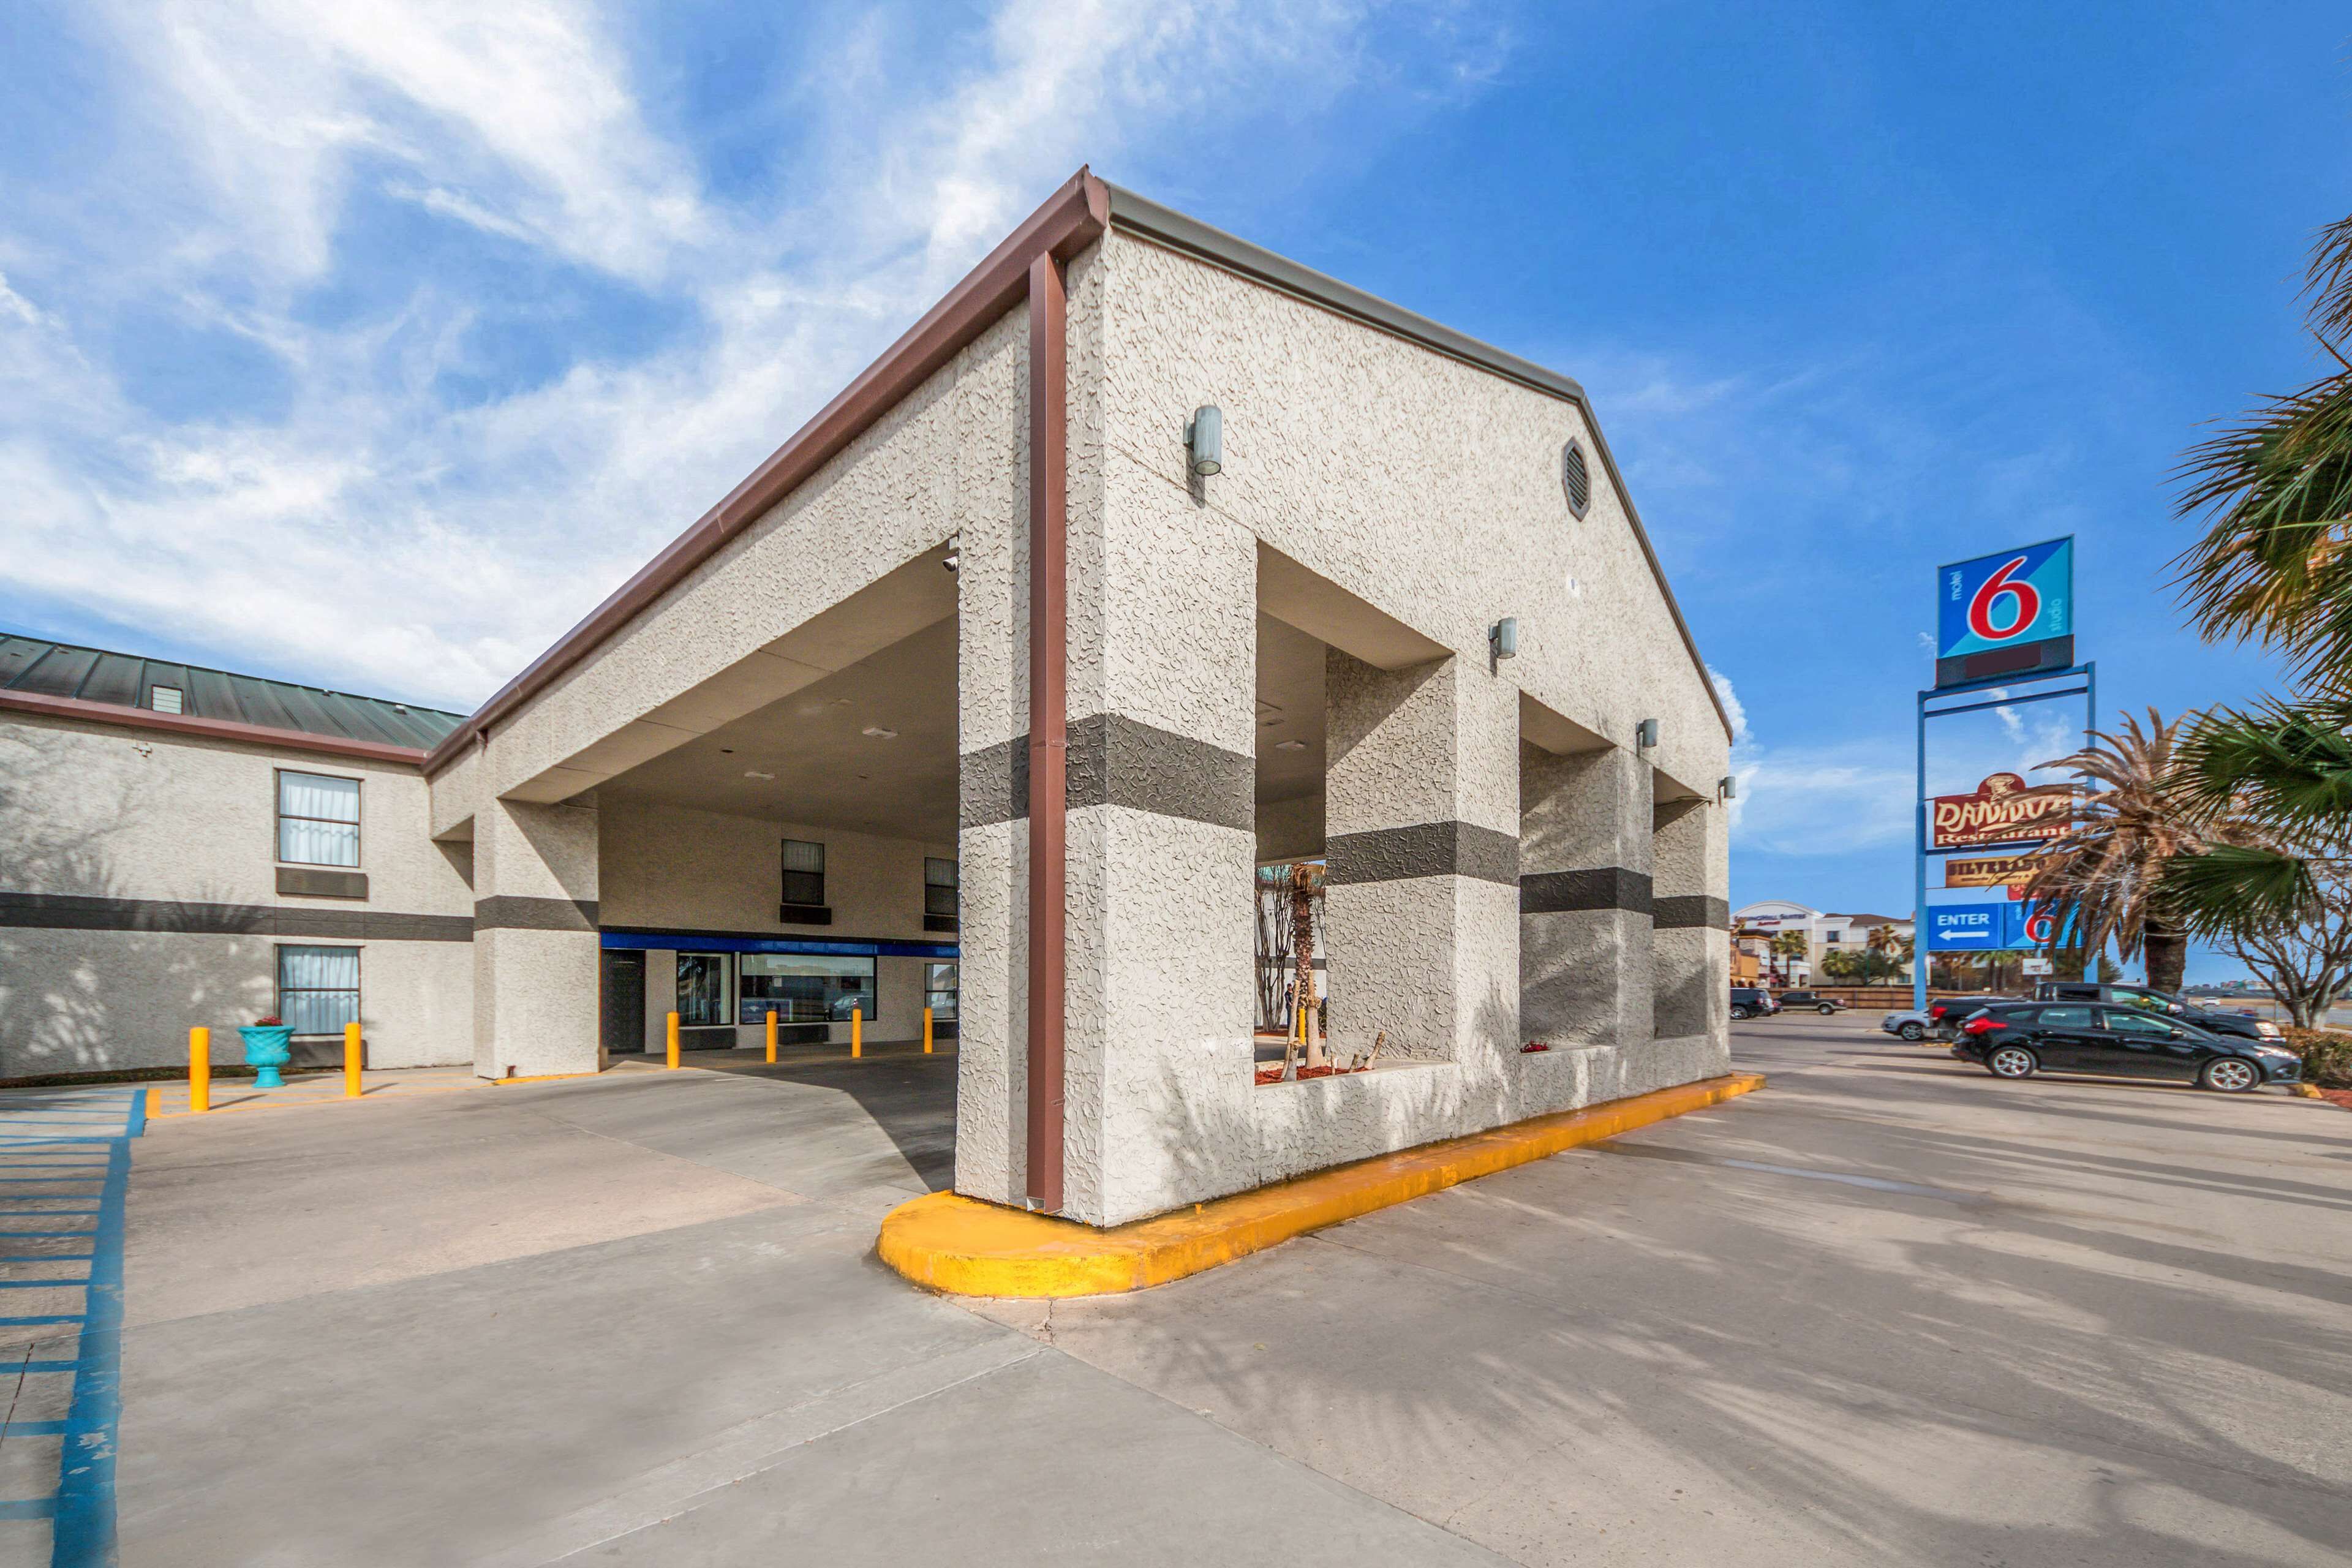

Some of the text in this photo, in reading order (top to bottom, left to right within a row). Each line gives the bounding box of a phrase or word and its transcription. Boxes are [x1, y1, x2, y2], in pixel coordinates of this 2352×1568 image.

[1967, 555, 2041, 641] 6
[1936, 826, 2070, 845] Resturant
[1937, 914, 1989, 926] ENTER
[2024, 903, 2056, 944] 6
